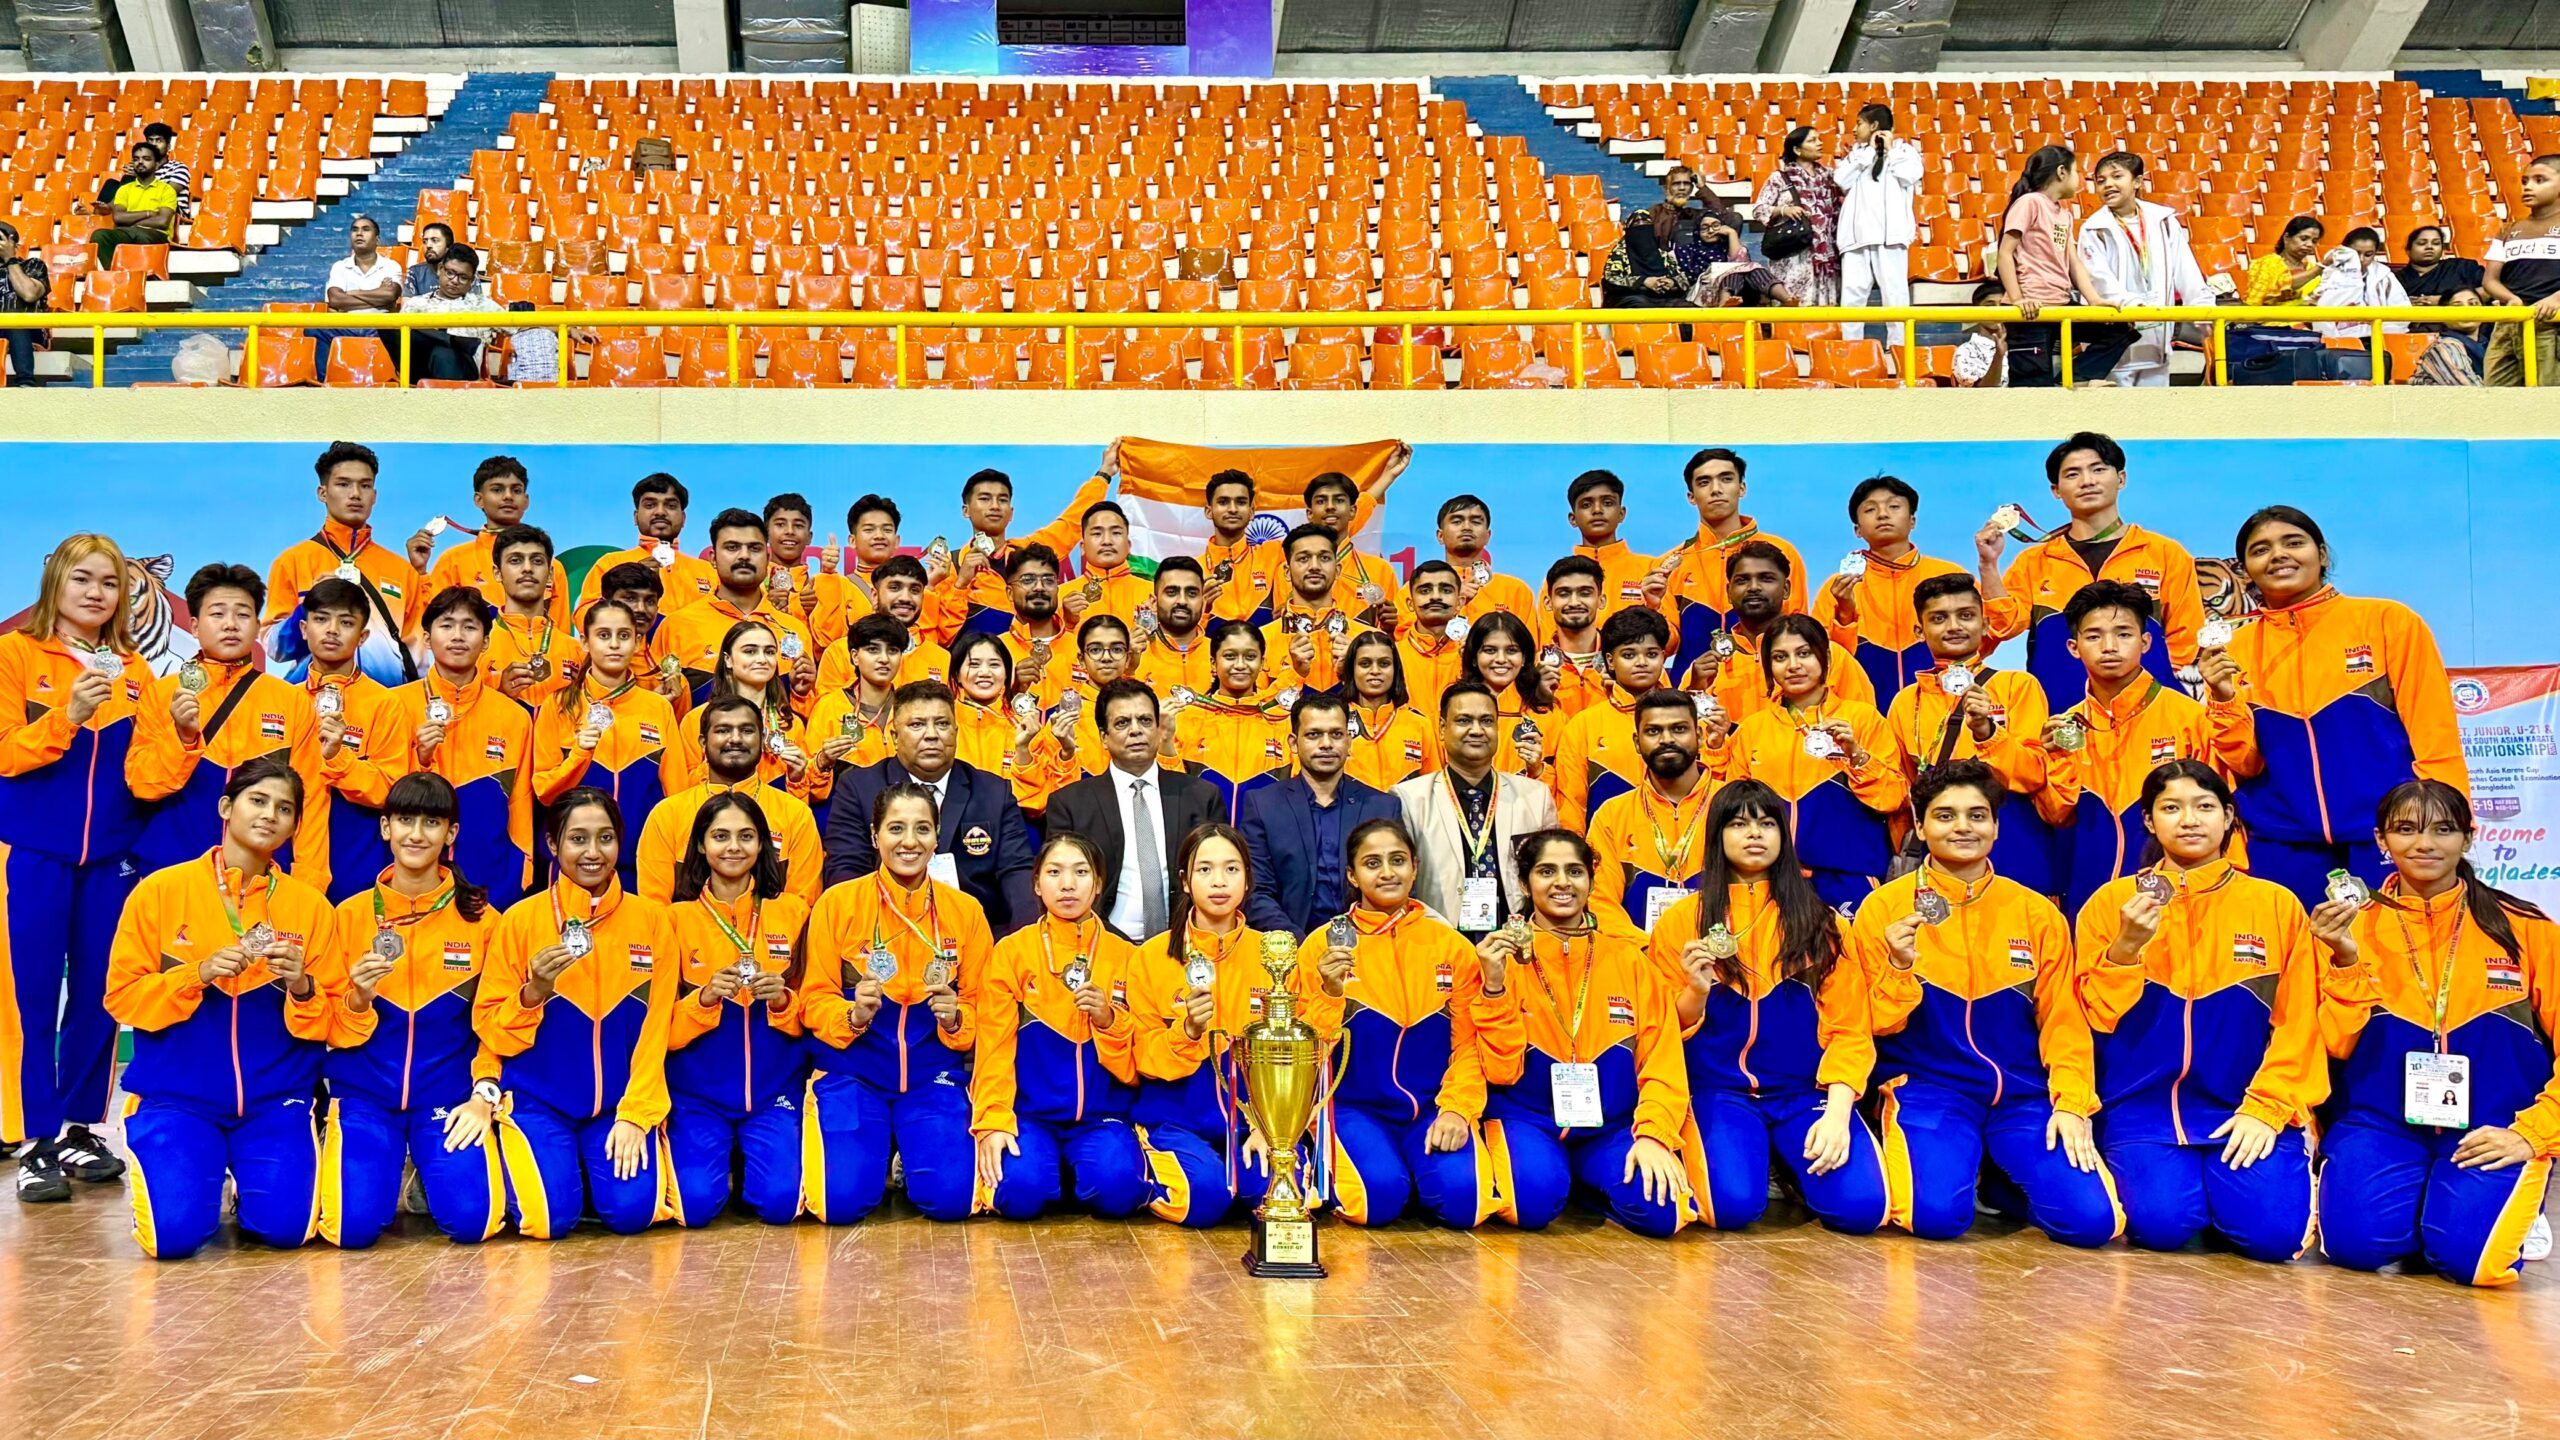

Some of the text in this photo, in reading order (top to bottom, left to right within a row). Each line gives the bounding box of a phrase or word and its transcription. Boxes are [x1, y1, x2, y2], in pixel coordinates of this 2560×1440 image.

[2134, 568, 2160, 576] INDIA
[2344, 645, 2371, 654] INDIA
[2517, 725, 2541, 735] U-21
[2151, 736, 2176, 744] INDIA
[2474, 737, 2499, 745] SOUTH
[2501, 736, 2524, 744] ASIAN
[2525, 735, 2555, 743] KARATE
[2465, 743, 2547, 757] AMPIONSHIP
[2526, 766, 2540, 775] Cup
[2477, 783, 2516, 792] Bangladesh
[2473, 799, 2494, 811] 5-19
[2493, 843, 2517, 861] to
[277, 931, 304, 940] INDIA
[2234, 933, 2264, 943] INDIA
[1608, 996, 1631, 1004] INDIA
